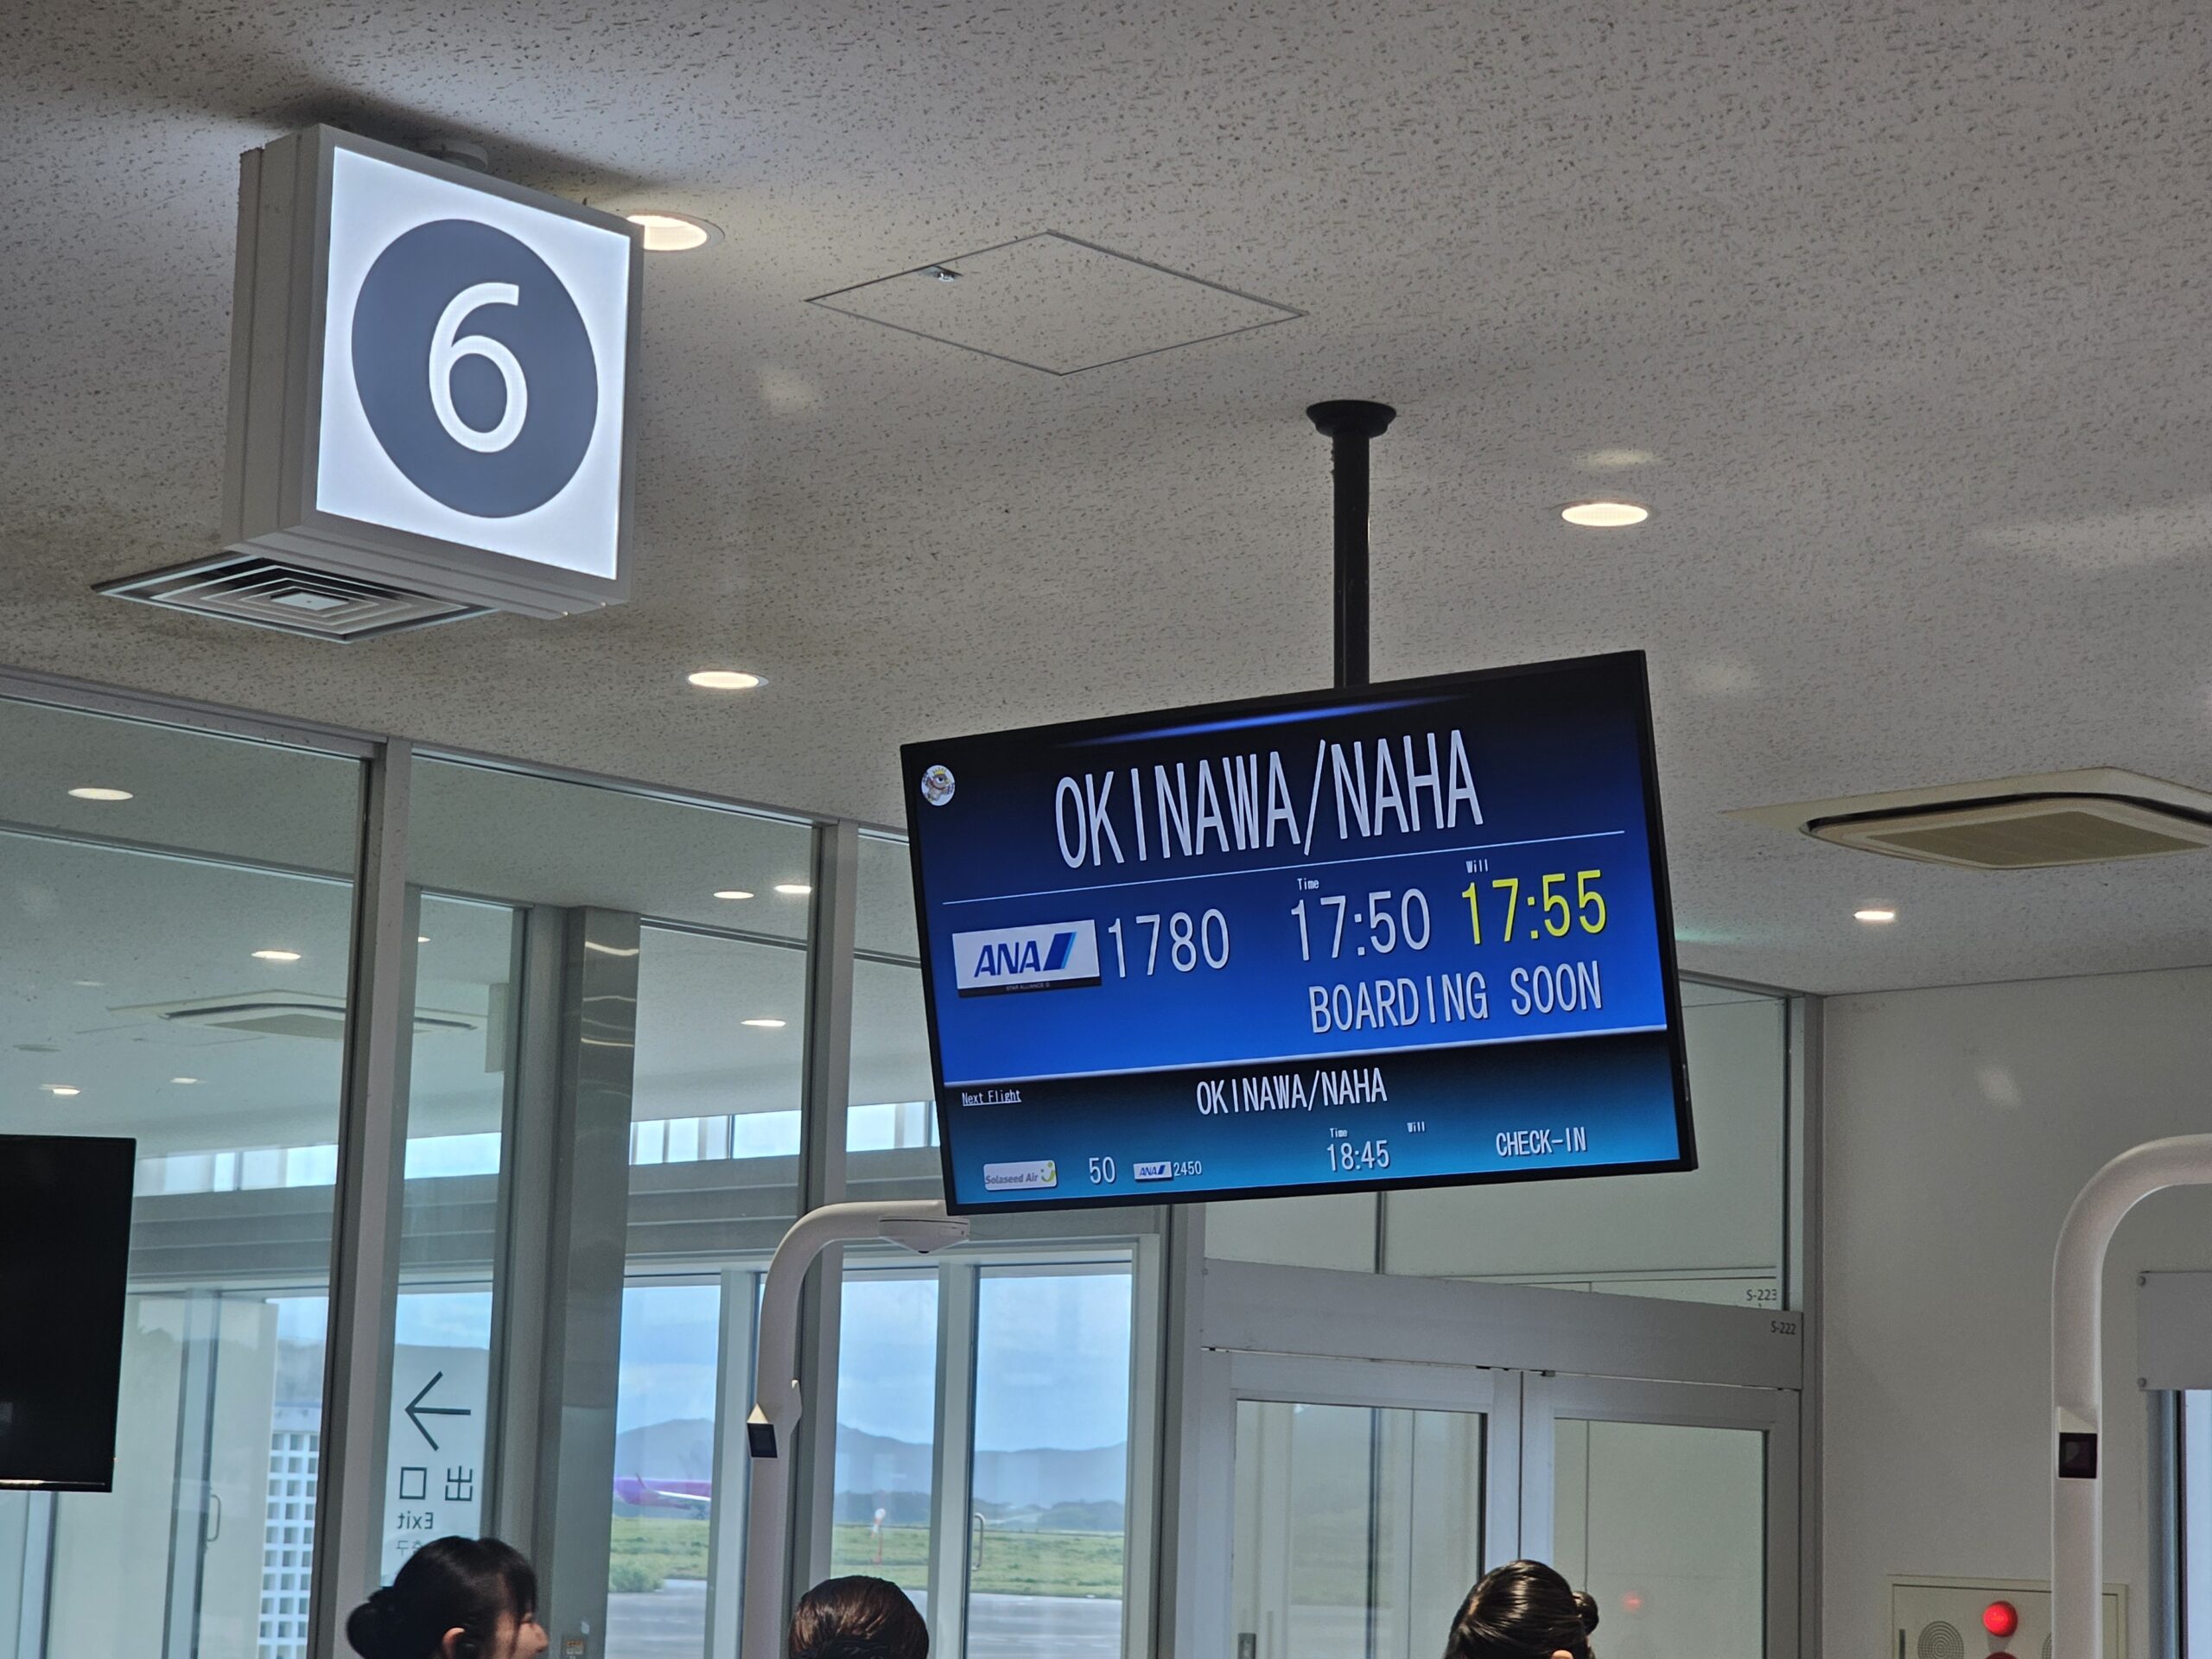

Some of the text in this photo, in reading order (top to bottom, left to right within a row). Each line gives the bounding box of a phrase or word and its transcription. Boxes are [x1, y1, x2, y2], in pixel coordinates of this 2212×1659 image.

[429, 282, 528, 454] 6
[1054, 728, 1484, 869] OKINAWA/NAHA
[1297, 876, 1320, 891] Time
[1461, 868, 1607, 945] 17:55
[1291, 888, 1432, 962] 17:50
[974, 940, 1041, 977] ANA
[1108, 908, 1230, 978] 1780
[1309, 961, 1603, 1034] BOARDING SOON
[962, 1089, 1022, 1106] Next Flight
[1196, 1067, 1389, 1116] OKINAWA/NAHA
[1330, 1127, 1348, 1138] Time
[1496, 1127, 1587, 1157] CHECK-IN
[1089, 1156, 1116, 1185] 50
[1139, 1167, 1157, 1176] ANA
[1173, 1160, 1203, 1177] 2450
[1327, 1140, 1390, 1173] 18:45
[985, 1173, 1039, 1185] Solaseed Air
[1770, 1320, 1796, 1335] S-222
